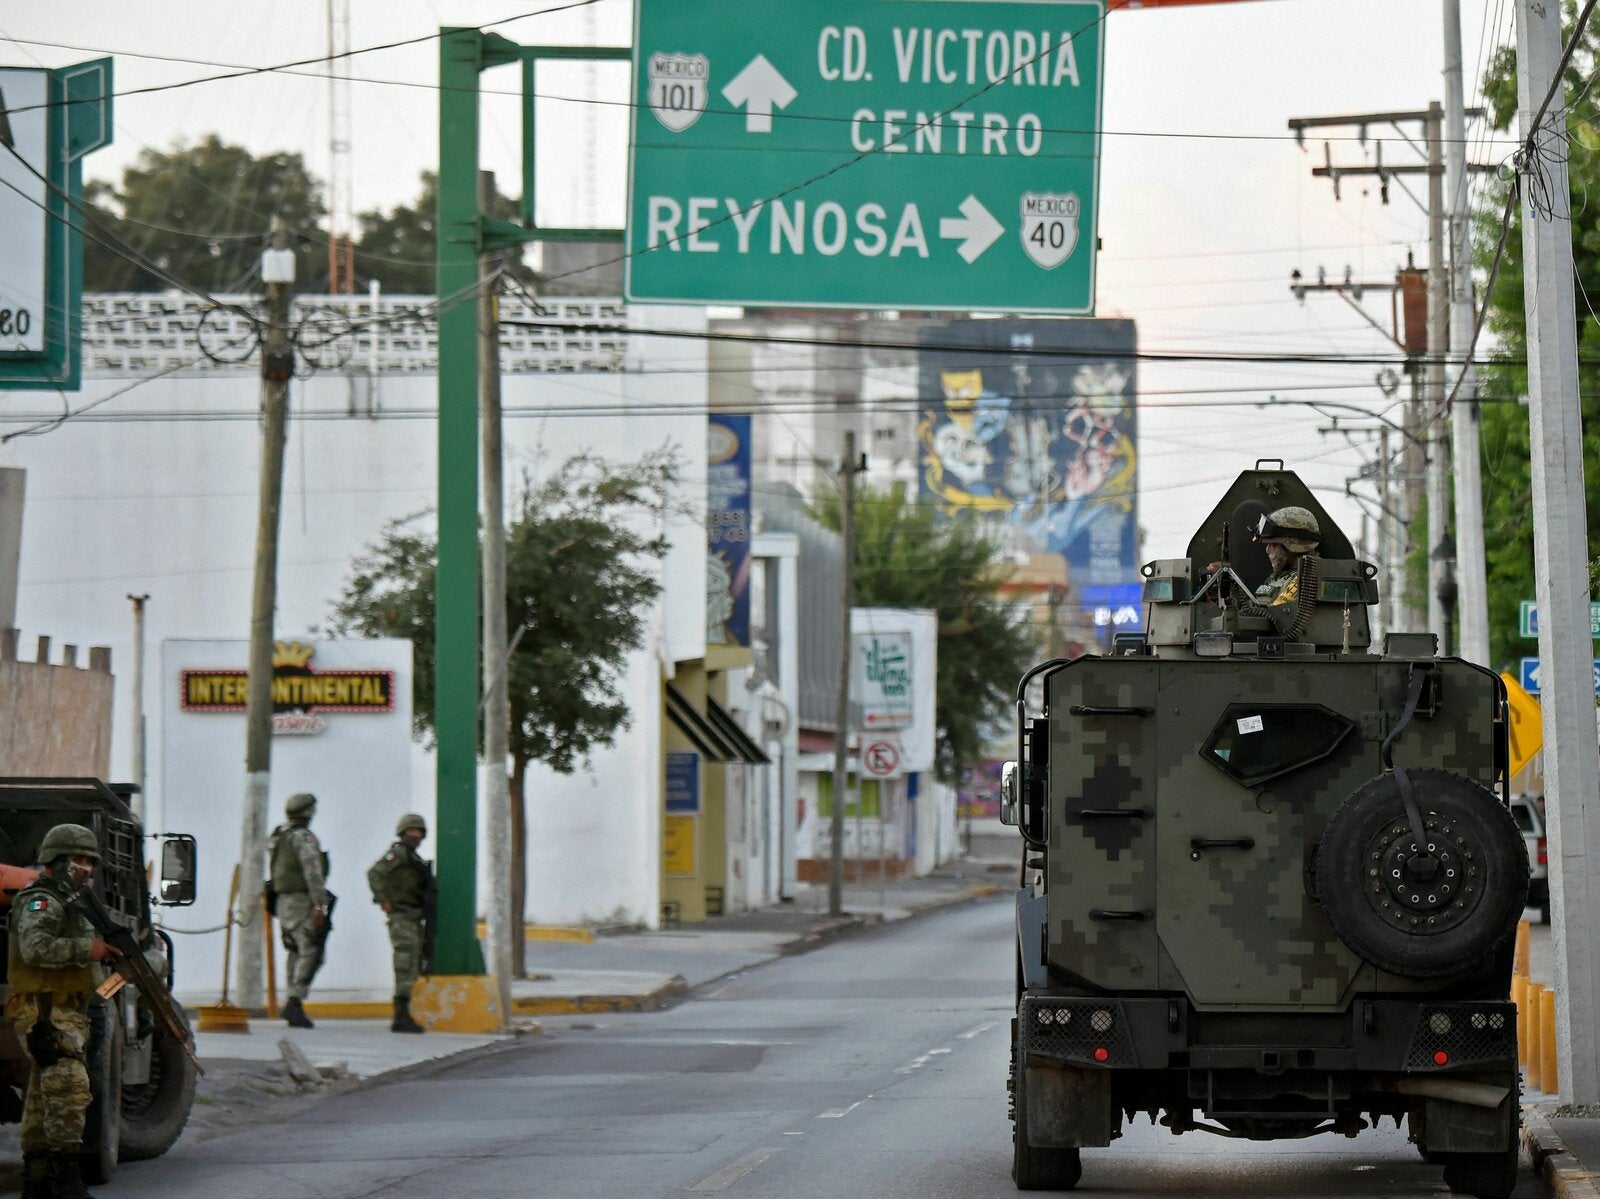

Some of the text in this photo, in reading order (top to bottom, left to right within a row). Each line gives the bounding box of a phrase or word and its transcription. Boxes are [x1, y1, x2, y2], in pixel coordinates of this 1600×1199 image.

[655, 61, 705, 76] MEXICO
[818, 26, 1080, 87] CD. VICTORIA
[662, 84, 694, 111] 101
[851, 109, 1042, 157] CENTRO
[1027, 199, 1076, 214] MEXICO
[648, 195, 930, 258] REYNOSA
[1030, 221, 1064, 249] 40
[189, 675, 386, 705] INTERONTINENTAL
